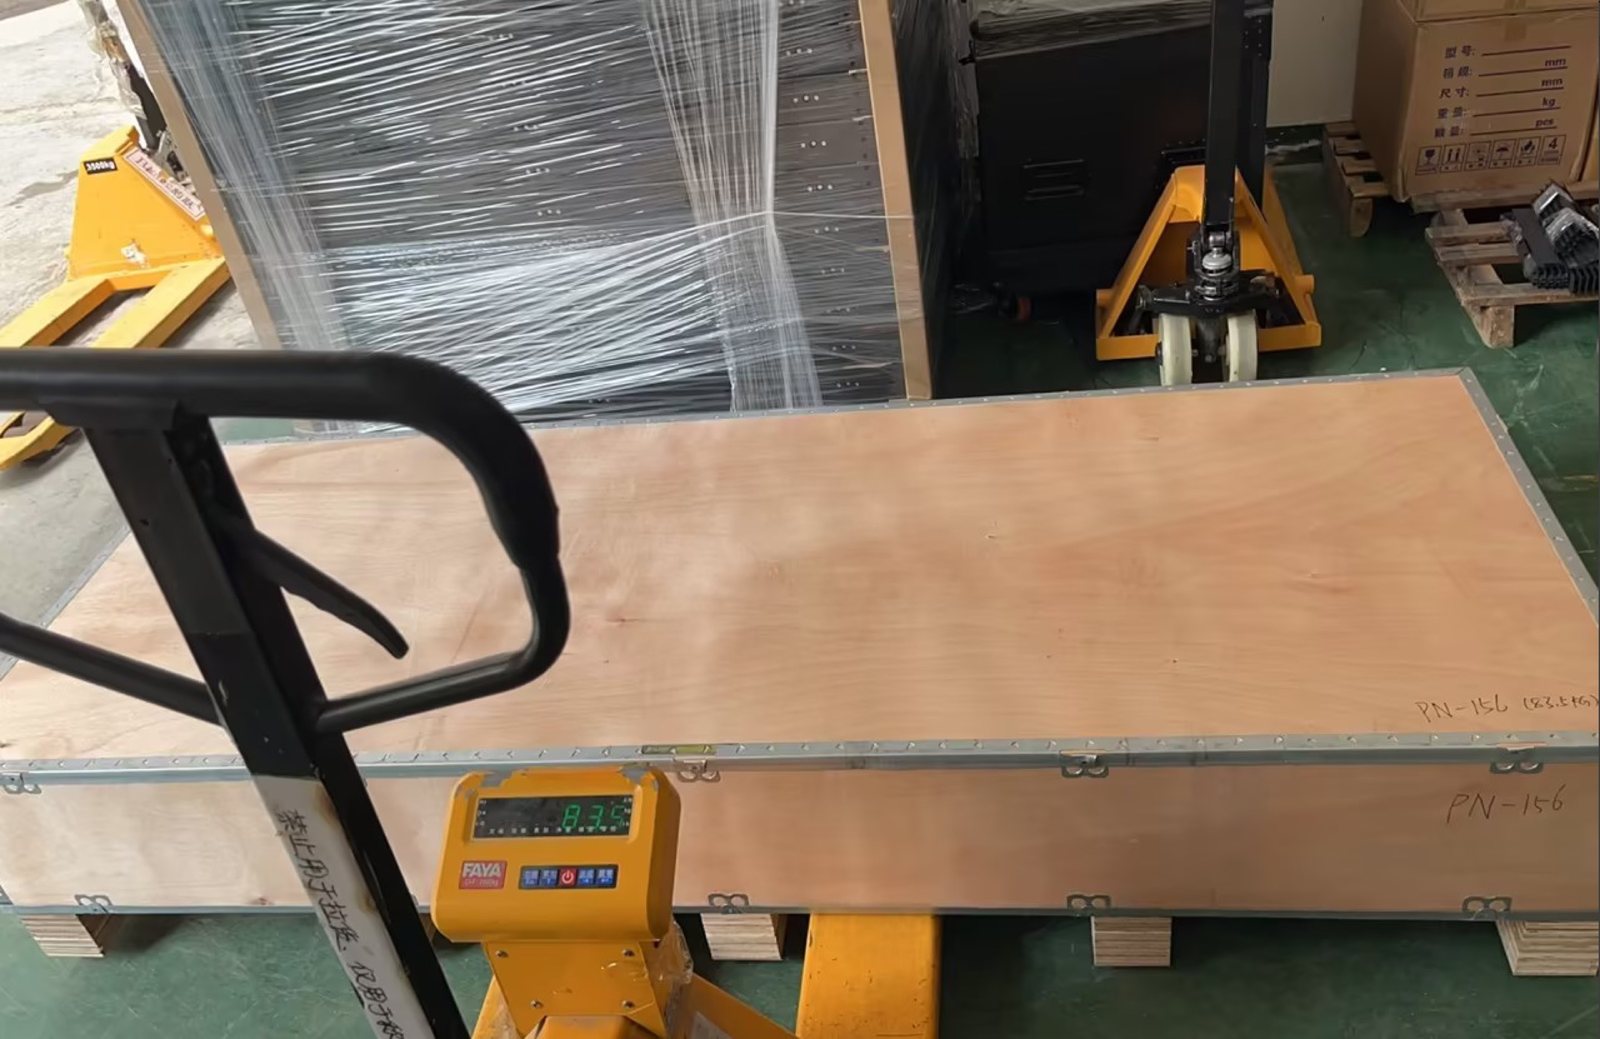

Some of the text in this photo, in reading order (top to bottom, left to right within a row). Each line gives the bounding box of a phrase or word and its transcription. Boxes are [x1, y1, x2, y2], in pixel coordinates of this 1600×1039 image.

[1545, 58, 1566, 67] mm
[1542, 97, 1556, 107] kg
[1548, 137, 1558, 149] 4
[1415, 694, 1508, 722] PN-156
[1446, 784, 1566, 823] PN-156
[462, 862, 501, 878] FAYA
